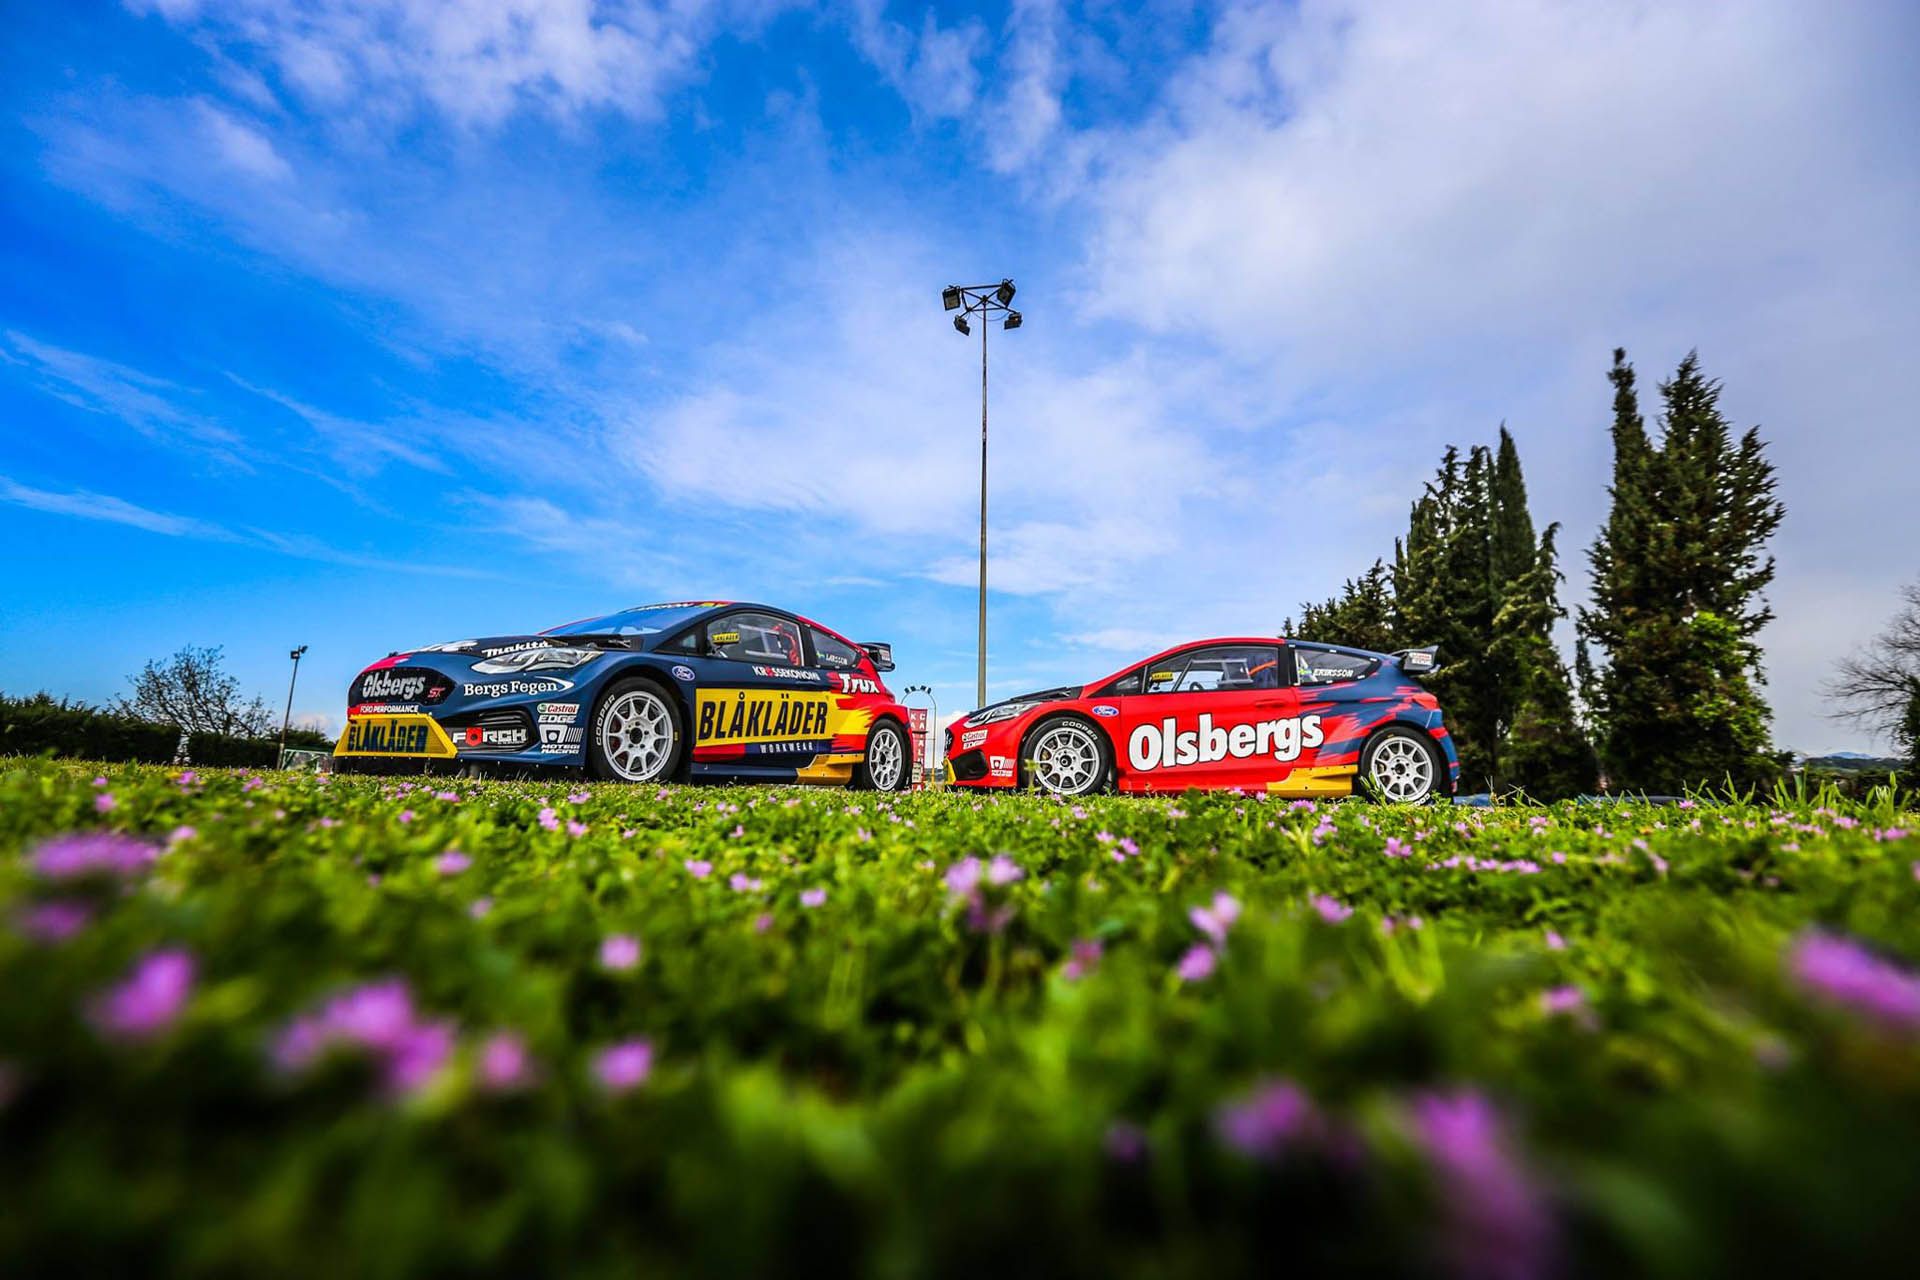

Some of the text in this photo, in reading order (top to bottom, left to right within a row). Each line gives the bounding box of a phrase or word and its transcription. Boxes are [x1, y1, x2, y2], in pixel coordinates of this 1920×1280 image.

[1313, 668, 1354, 678] ERIKSSON
[362, 671, 426, 700] Olsbergs
[427, 687, 446, 698] ST
[463, 680, 558, 698] Bergs Fegen
[838, 673, 880, 694] Trux
[360, 705, 419, 713] FORD PERFORMANCE
[547, 704, 577, 713] Castrol
[698, 691, 829, 741] BLÅKLÄDER
[538, 714, 577, 723] EDGE
[595, 694, 616, 746] COOPER
[1062, 721, 1098, 740] COOPER
[760, 742, 814, 753] WORKWEAR
[1128, 713, 1325, 771] Olsbergs
